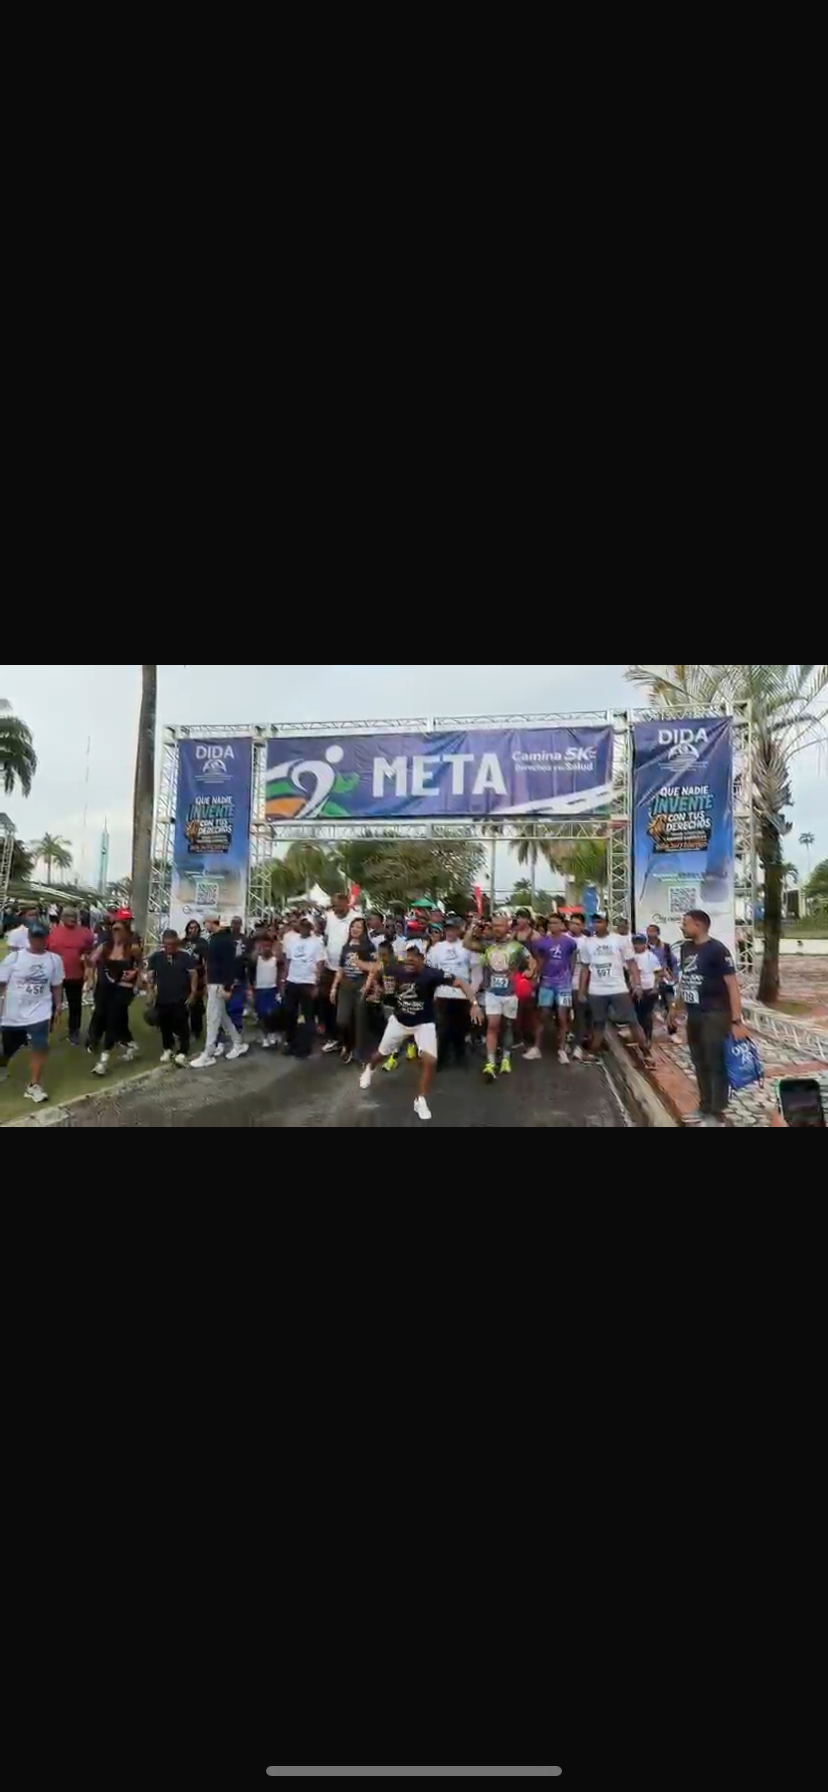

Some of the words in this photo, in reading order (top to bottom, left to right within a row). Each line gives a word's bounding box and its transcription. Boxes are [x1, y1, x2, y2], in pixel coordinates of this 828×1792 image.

[658, 727, 708, 745] DIDA
[195, 745, 235, 759] DIDA
[512, 750, 562, 761] Camina
[565, 762, 594, 771] Salud
[372, 753, 508, 797] META
[660, 786, 680, 797] QUE
[681, 785, 709, 796] NADIE
[652, 794, 714, 816] INVENTE
[668, 812, 686, 822] CON
[688, 810, 705, 821] TUS
[200, 819, 214, 827] CON
[666, 818, 711, 832] DERECHOS
